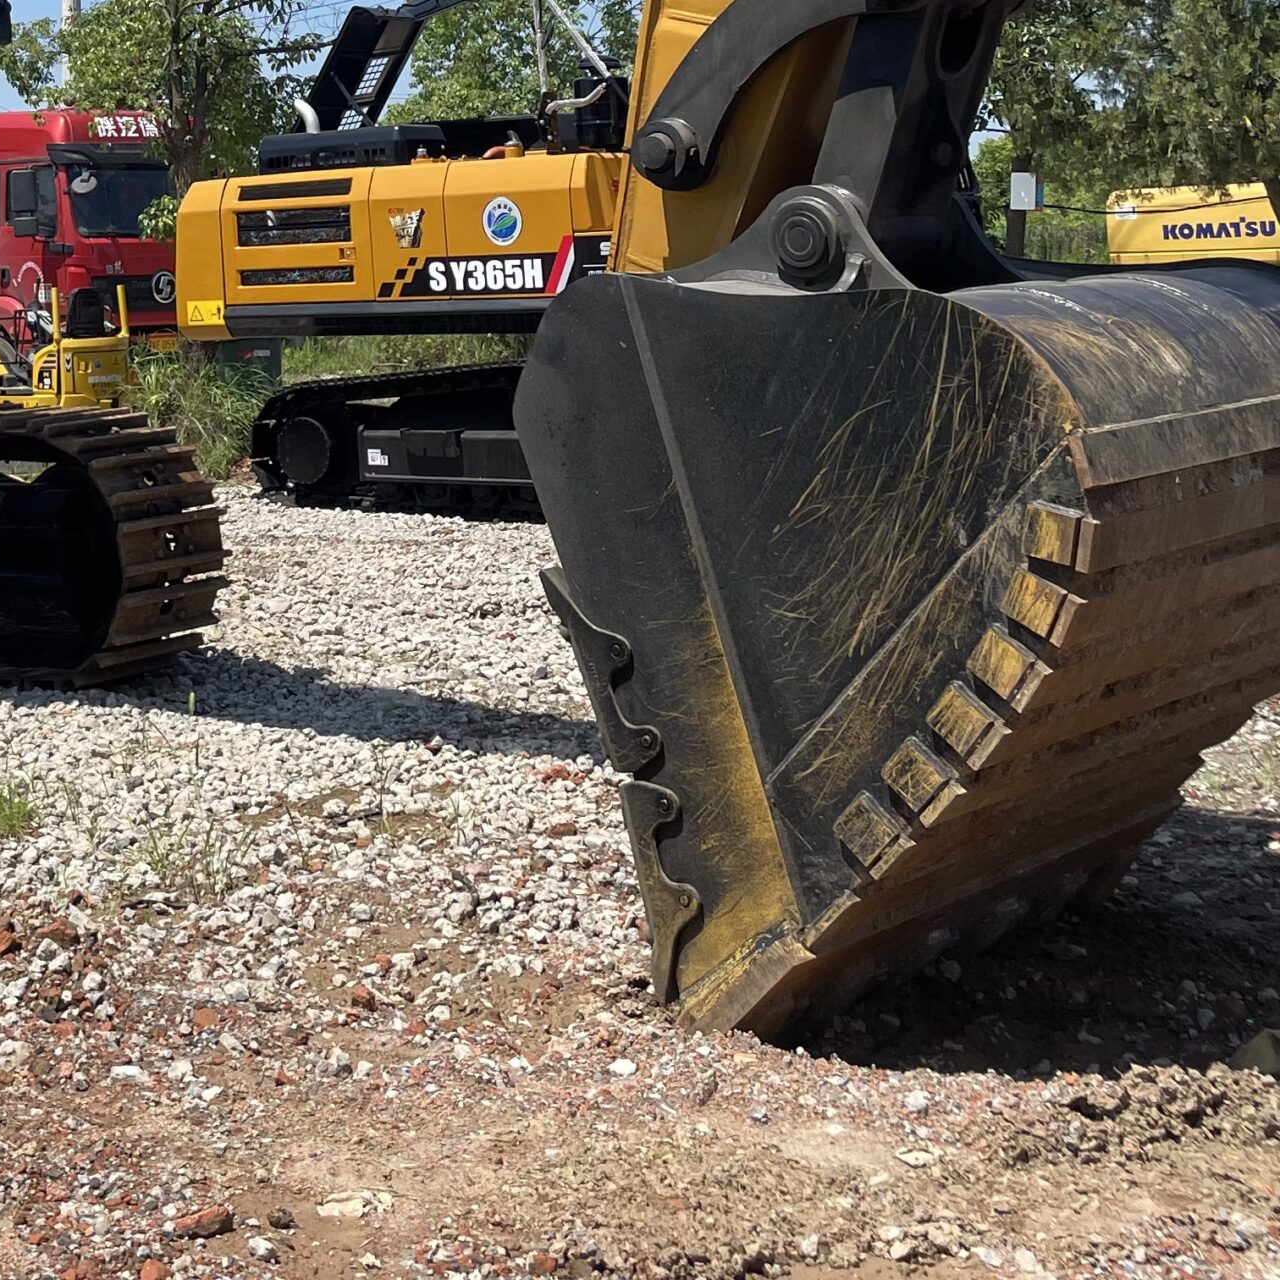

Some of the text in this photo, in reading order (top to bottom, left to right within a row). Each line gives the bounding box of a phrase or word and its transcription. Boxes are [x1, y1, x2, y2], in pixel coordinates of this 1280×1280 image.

[94, 116, 172, 138] 陕汽德
[1162, 216, 1276, 240] KOMATSU
